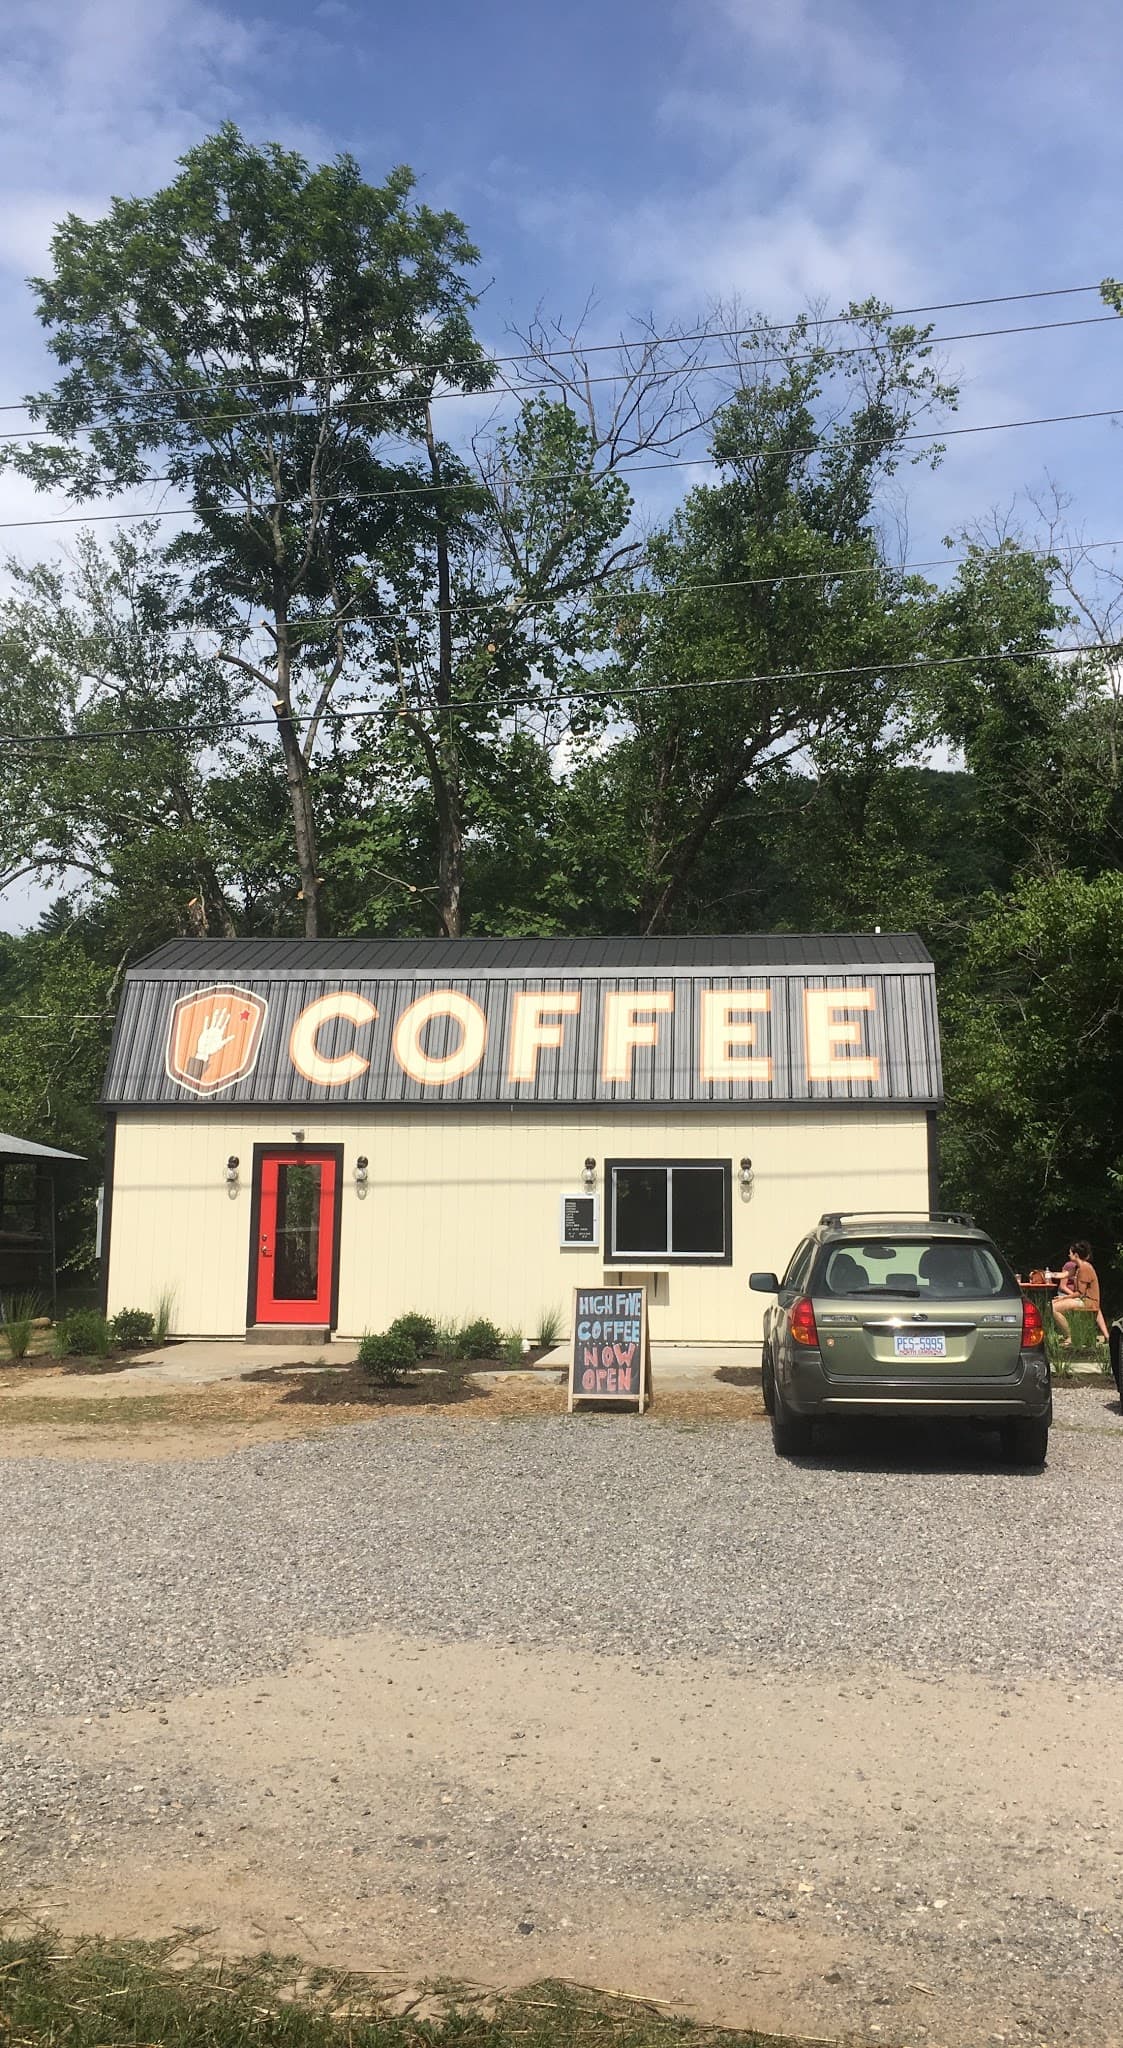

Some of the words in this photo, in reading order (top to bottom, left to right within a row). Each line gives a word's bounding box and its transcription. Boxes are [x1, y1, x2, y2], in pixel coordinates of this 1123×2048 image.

[289, 988, 880, 1086] COFFEE
[579, 1295, 613, 1315] HIGH
[615, 1292, 641, 1316] FIVE
[577, 1320, 640, 1342] COFFEE
[583, 1342, 636, 1367] NOW
[896, 1337, 944, 1351] PES-5995
[581, 1367, 632, 1392] OPEN
